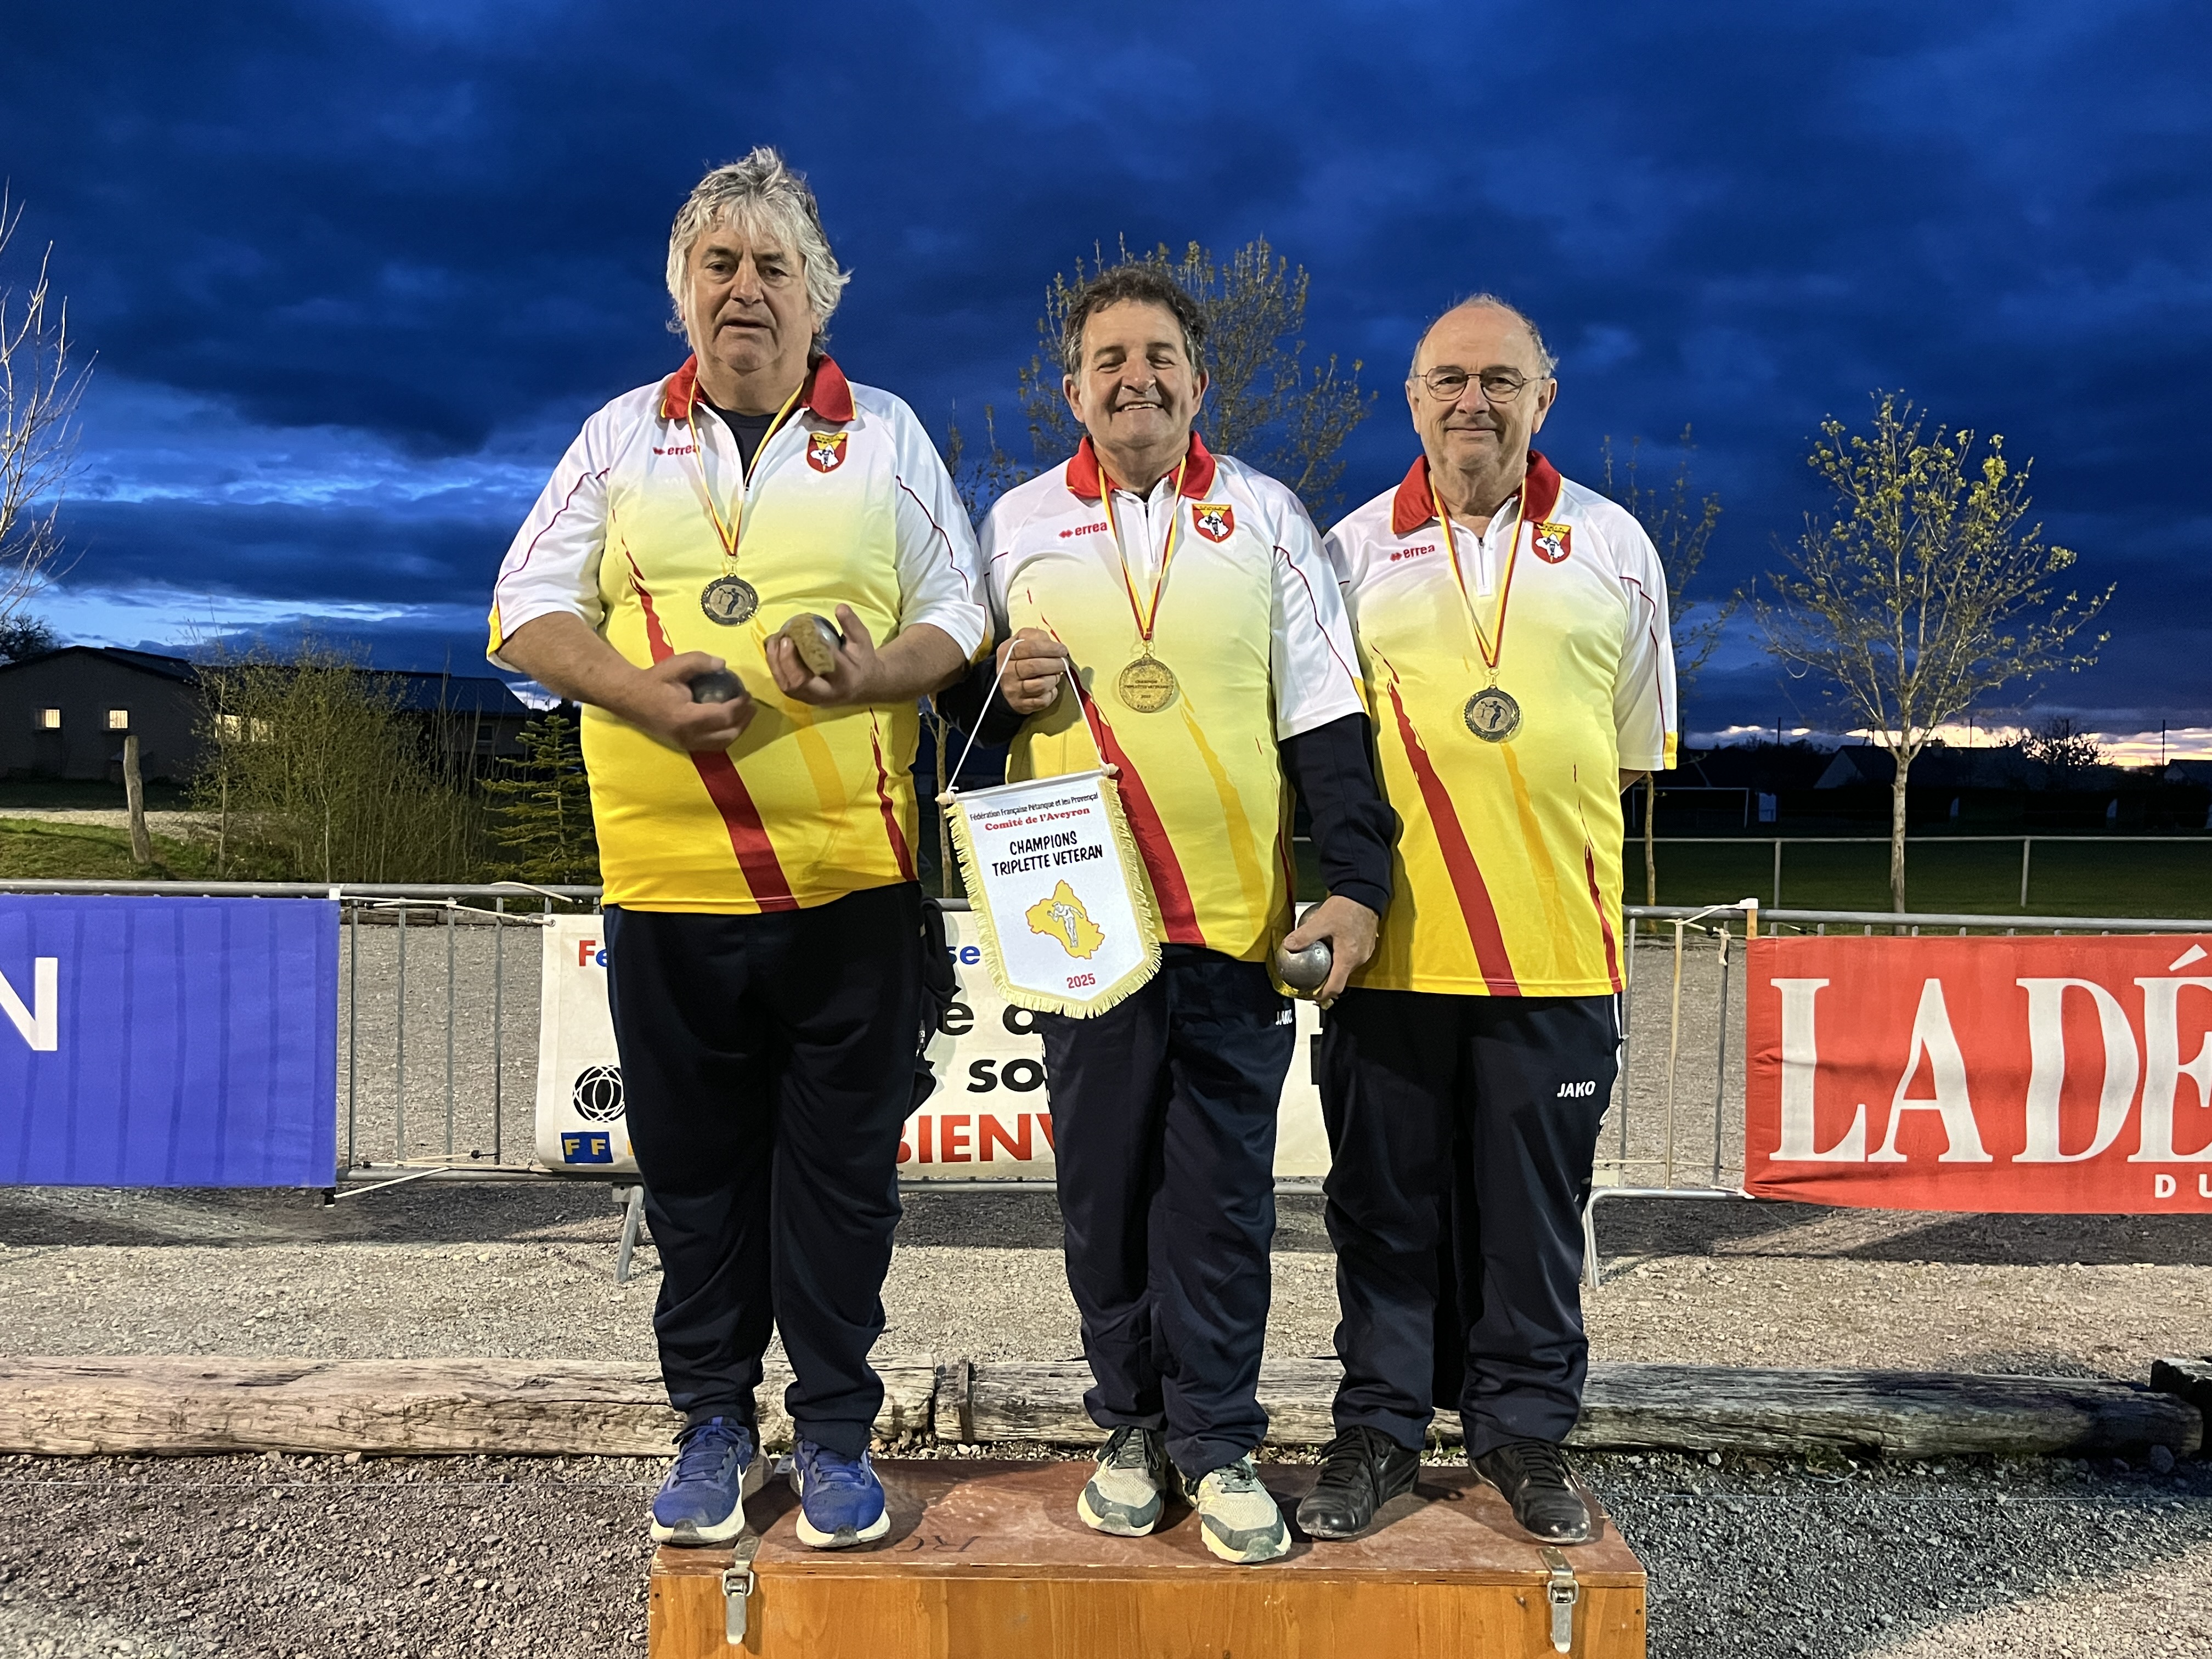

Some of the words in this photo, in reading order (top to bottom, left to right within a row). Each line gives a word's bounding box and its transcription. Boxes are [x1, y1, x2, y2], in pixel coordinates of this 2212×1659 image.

[1075, 522, 1107, 536] errea
[1403, 545, 1435, 558] errea
[969, 810, 1002, 821] Fédération
[1001, 805, 1028, 816] Française
[1028, 800, 1055, 811] Pétanque
[1071, 792, 1099, 804] Provençal
[985, 817, 1023, 831] Comité
[1025, 816, 1037, 824] de
[1039, 807, 1091, 822] l'Aveyron
[1009, 831, 1077, 855] CHAMPIONS
[992, 854, 1051, 877] TRIPLETTE
[1052, 844, 1103, 866] VETERAN
[1066, 973, 1096, 989] 2025
[1769, 978, 1993, 1163] LA
[1557, 1081, 1596, 1098] JAKO
[564, 1138, 634, 1156] FF
